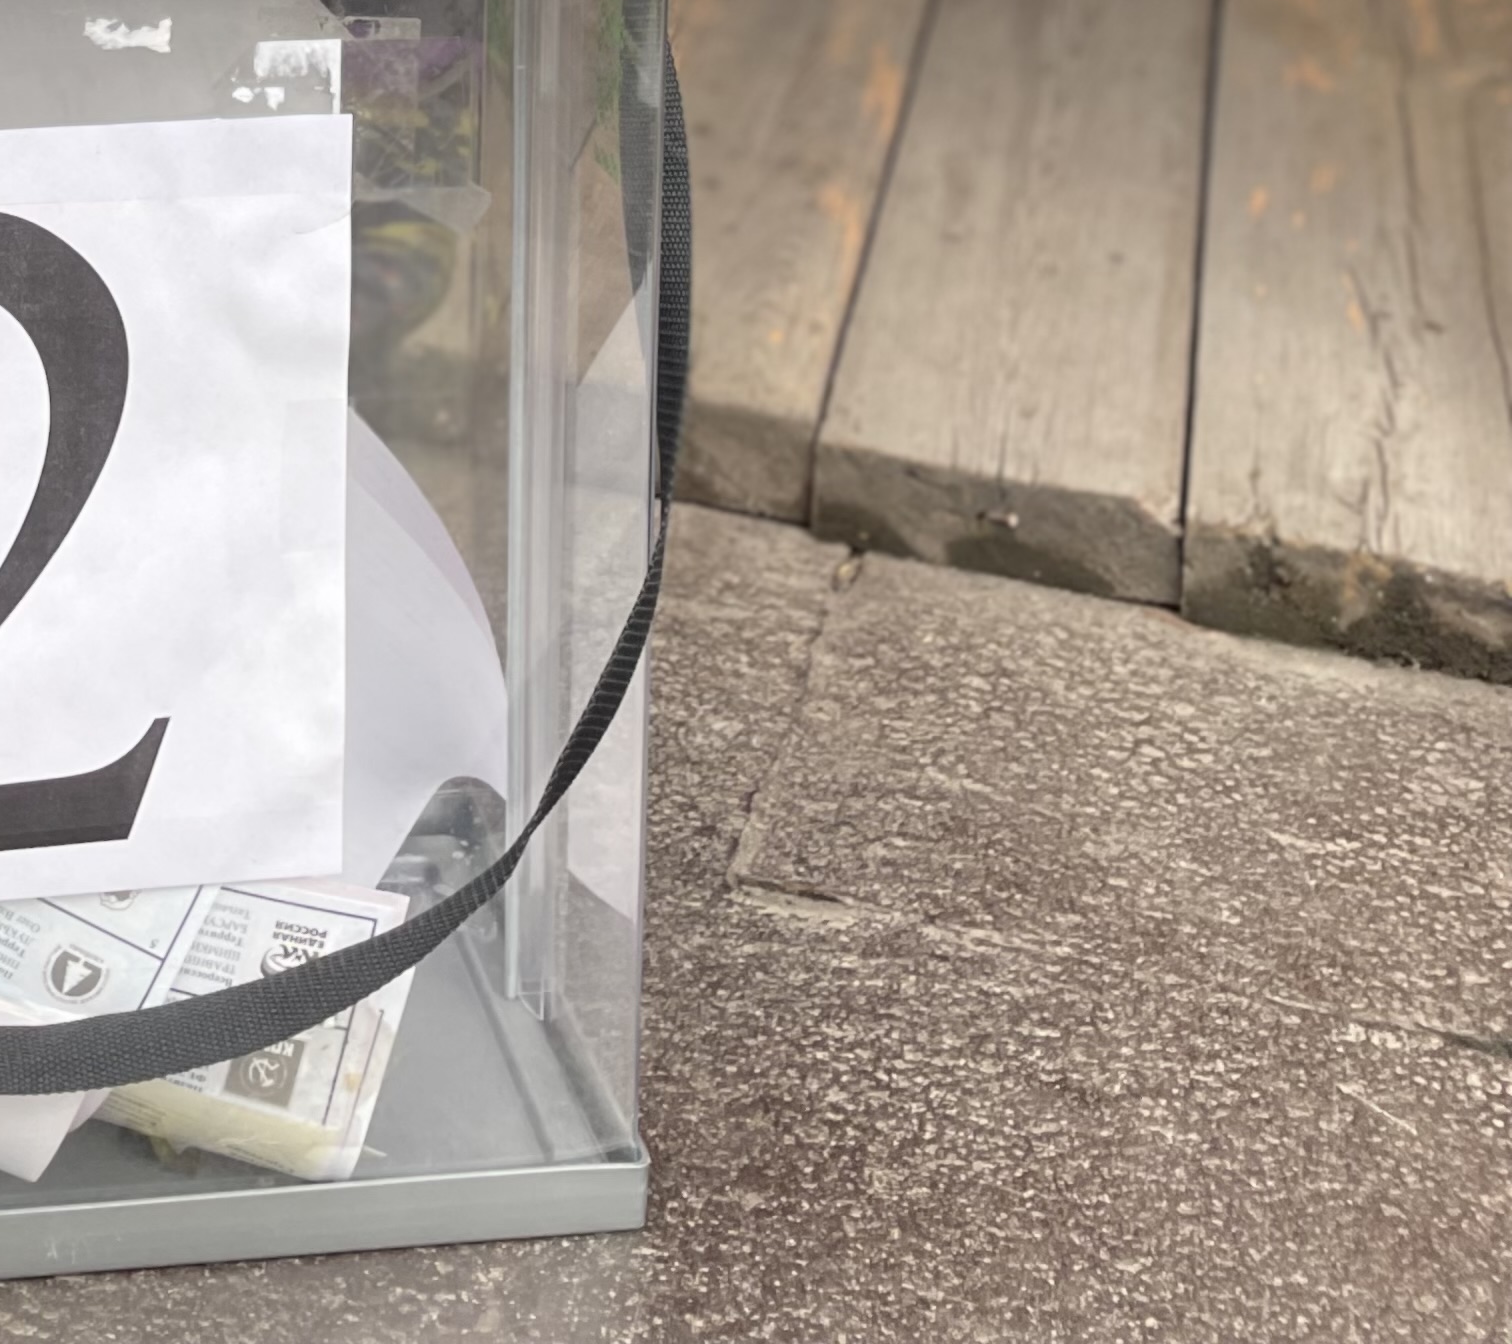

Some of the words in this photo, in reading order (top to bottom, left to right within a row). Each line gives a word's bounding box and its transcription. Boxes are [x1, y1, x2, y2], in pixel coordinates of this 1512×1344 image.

[275, 920, 327, 938] РОССИЯ
[272, 931, 324, 948] ЕДИНАЯ
[263, 1041, 294, 1056] КП
